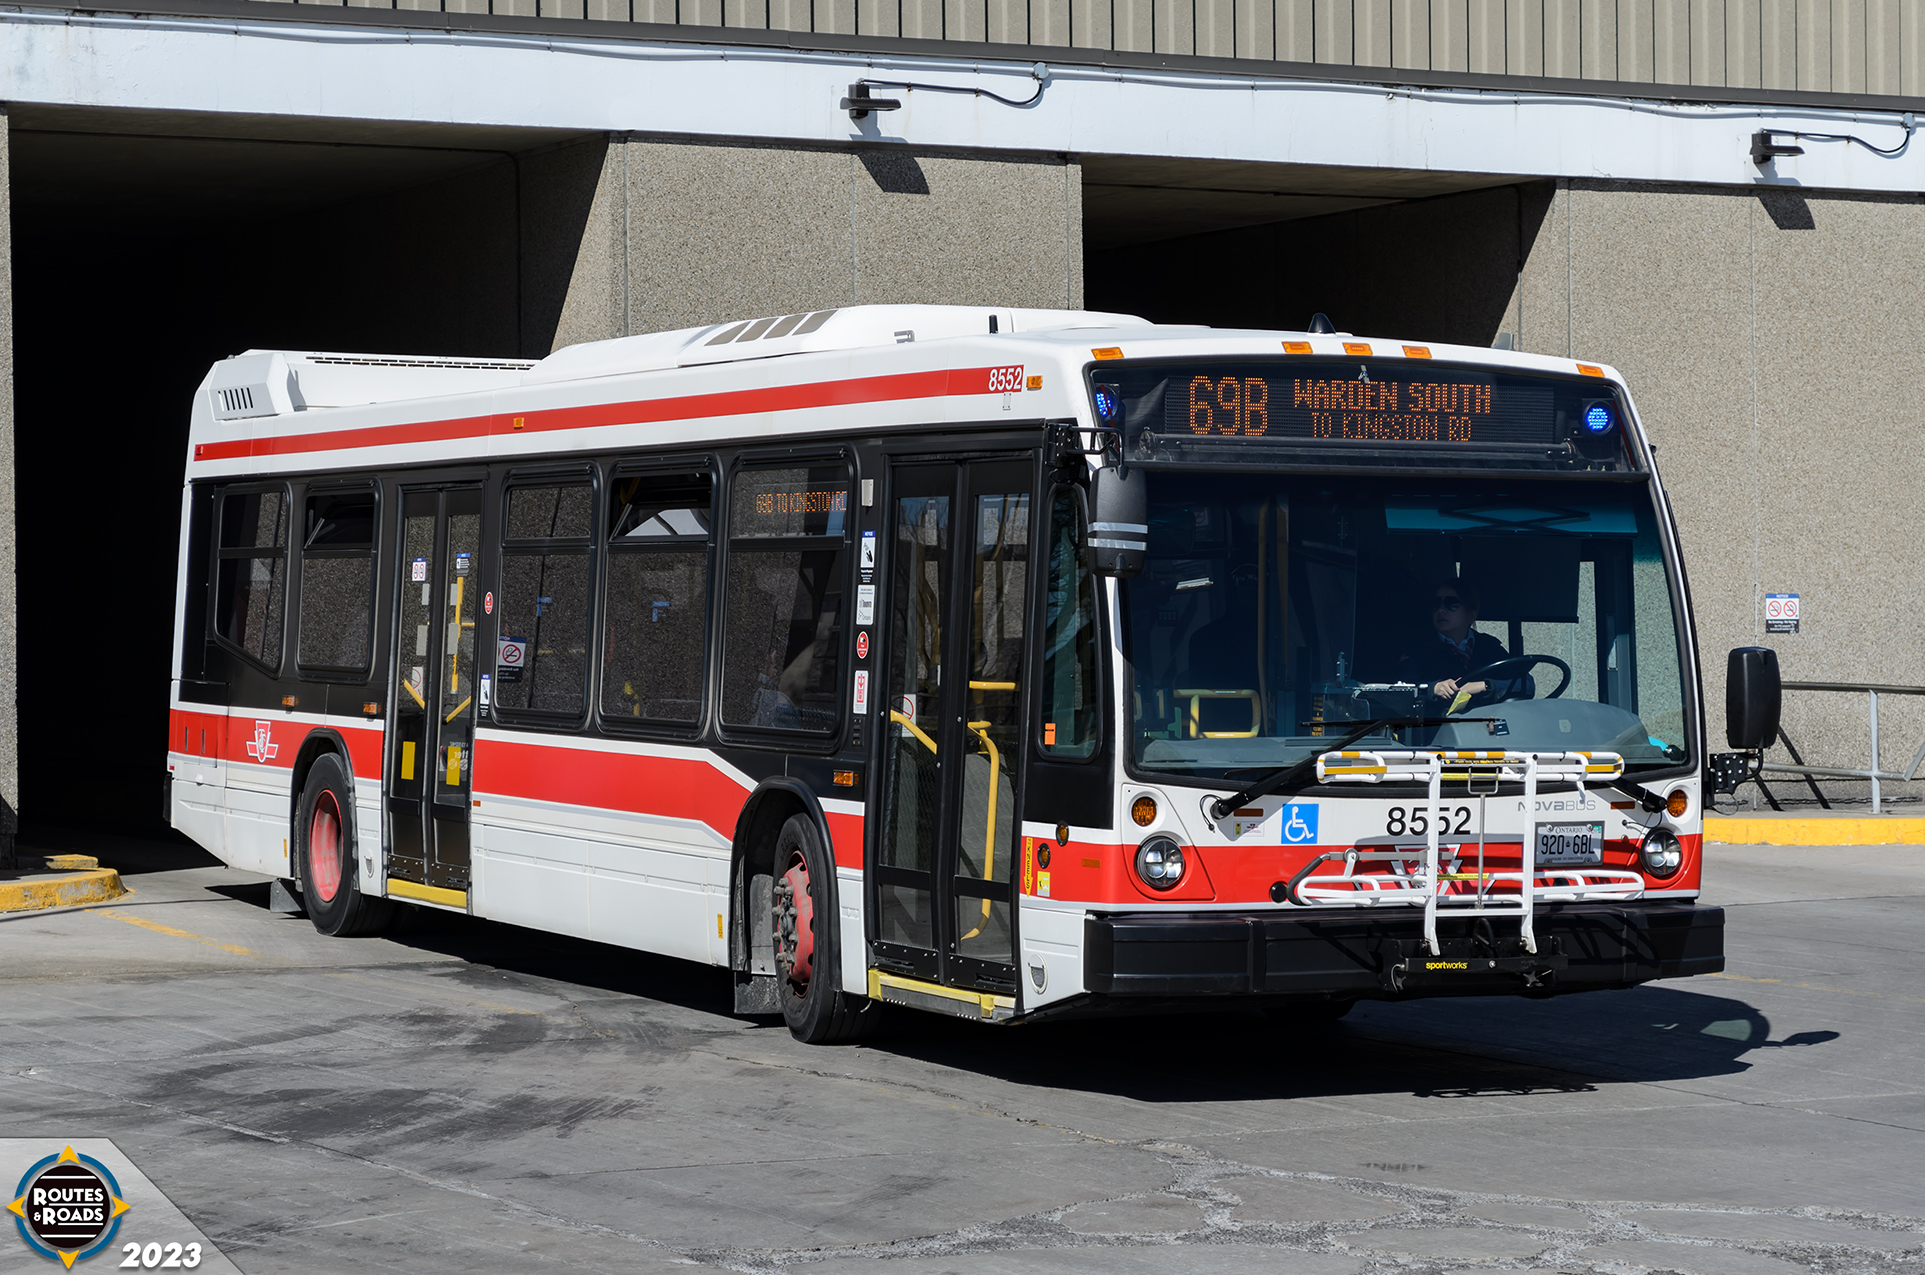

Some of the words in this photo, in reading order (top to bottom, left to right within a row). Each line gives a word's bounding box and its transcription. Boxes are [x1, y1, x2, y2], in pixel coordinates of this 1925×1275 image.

[988, 367, 1022, 391] 8552
[1190, 375, 1268, 436] 69B
[1293, 378, 1398, 411] WARDEN
[1409, 382, 1491, 413] SOUTH
[1312, 412, 1332, 438] TO
[1343, 413, 1438, 441] KINGSTON
[1449, 416, 1472, 441] RD
[756, 493, 774, 513] 69B
[776, 492, 788, 513] TO
[1386, 806, 1472, 836] 8552
[1541, 834, 1565, 855] 920
[1425, 961, 1468, 970] sportworks
